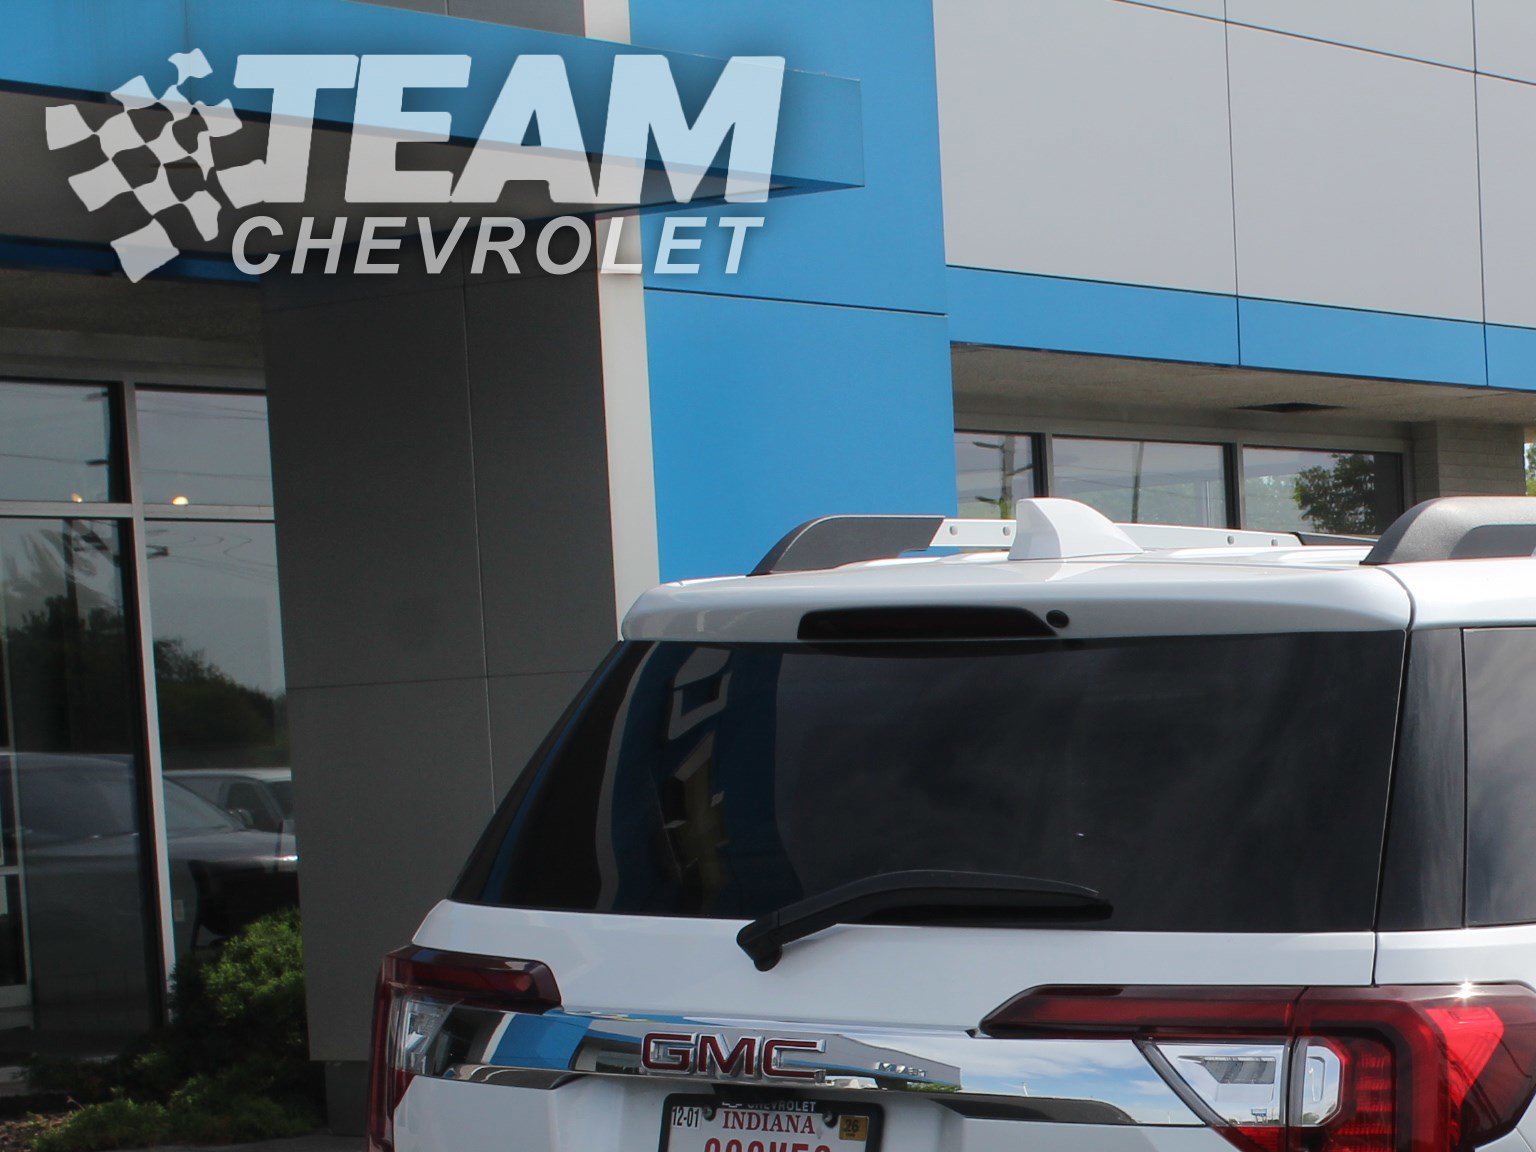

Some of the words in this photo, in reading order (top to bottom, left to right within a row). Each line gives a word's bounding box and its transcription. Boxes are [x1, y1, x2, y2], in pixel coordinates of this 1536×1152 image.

[642, 1032, 827, 1083] GMC
[671, 1106, 700, 1128] 12-01
[722, 1111, 816, 1135] INDIANA
